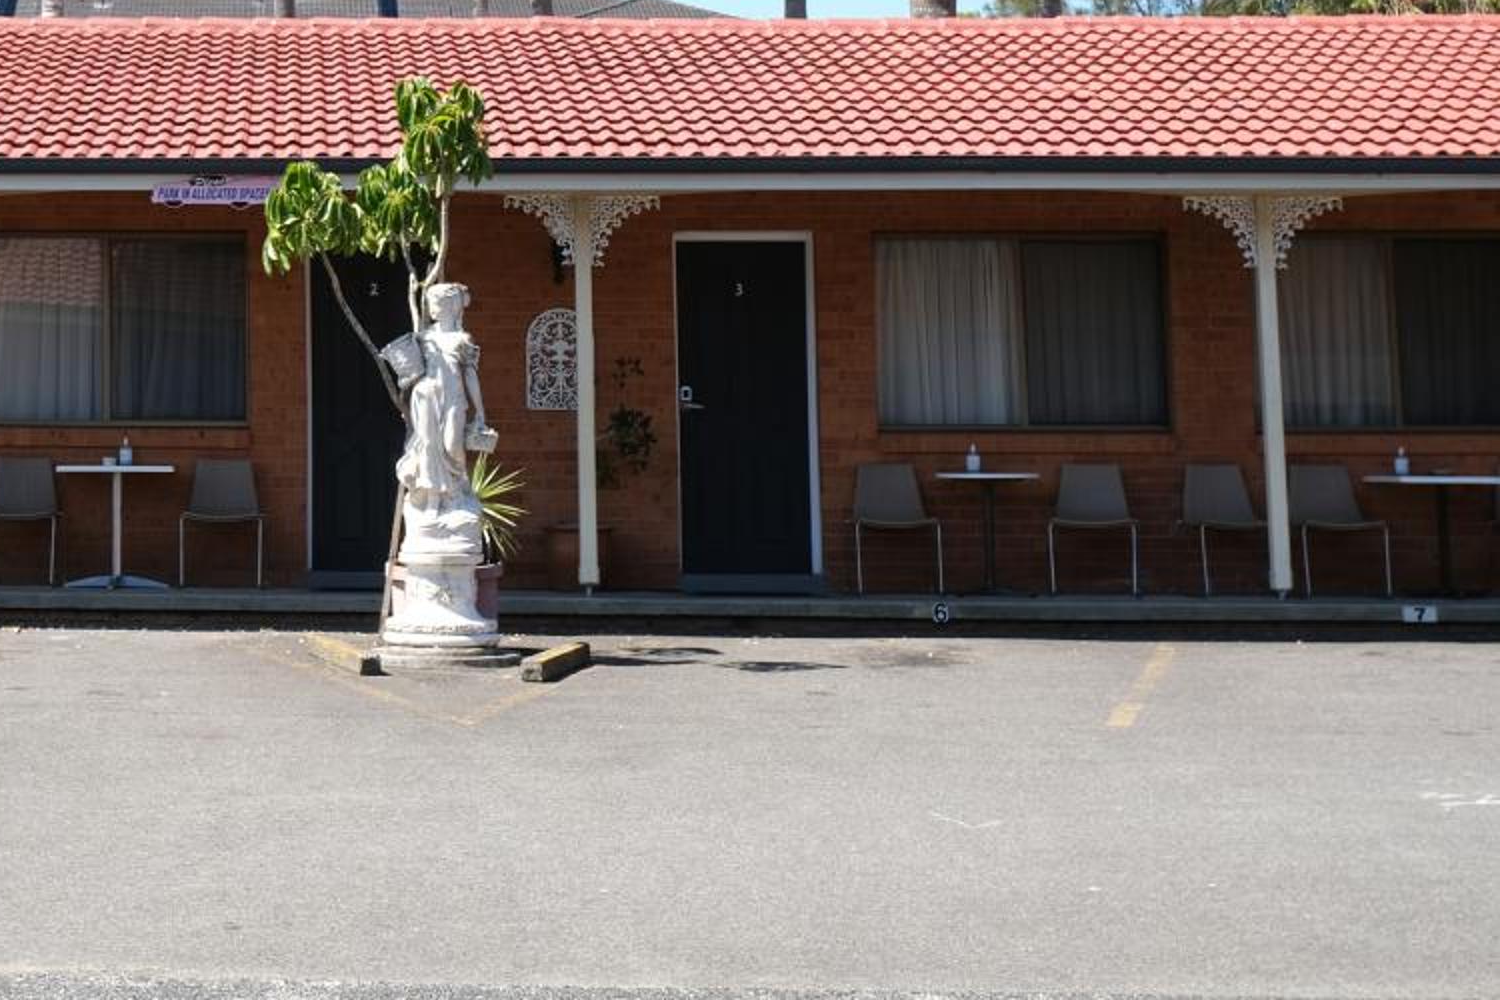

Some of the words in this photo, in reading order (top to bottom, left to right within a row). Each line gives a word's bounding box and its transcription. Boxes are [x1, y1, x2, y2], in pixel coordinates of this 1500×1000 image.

[157, 187, 180, 199] PARK
[191, 187, 237, 199] ALLOCATED
[734, 283, 743, 297] 3
[934, 602, 948, 622] 6
[1414, 607, 1426, 621] 7
